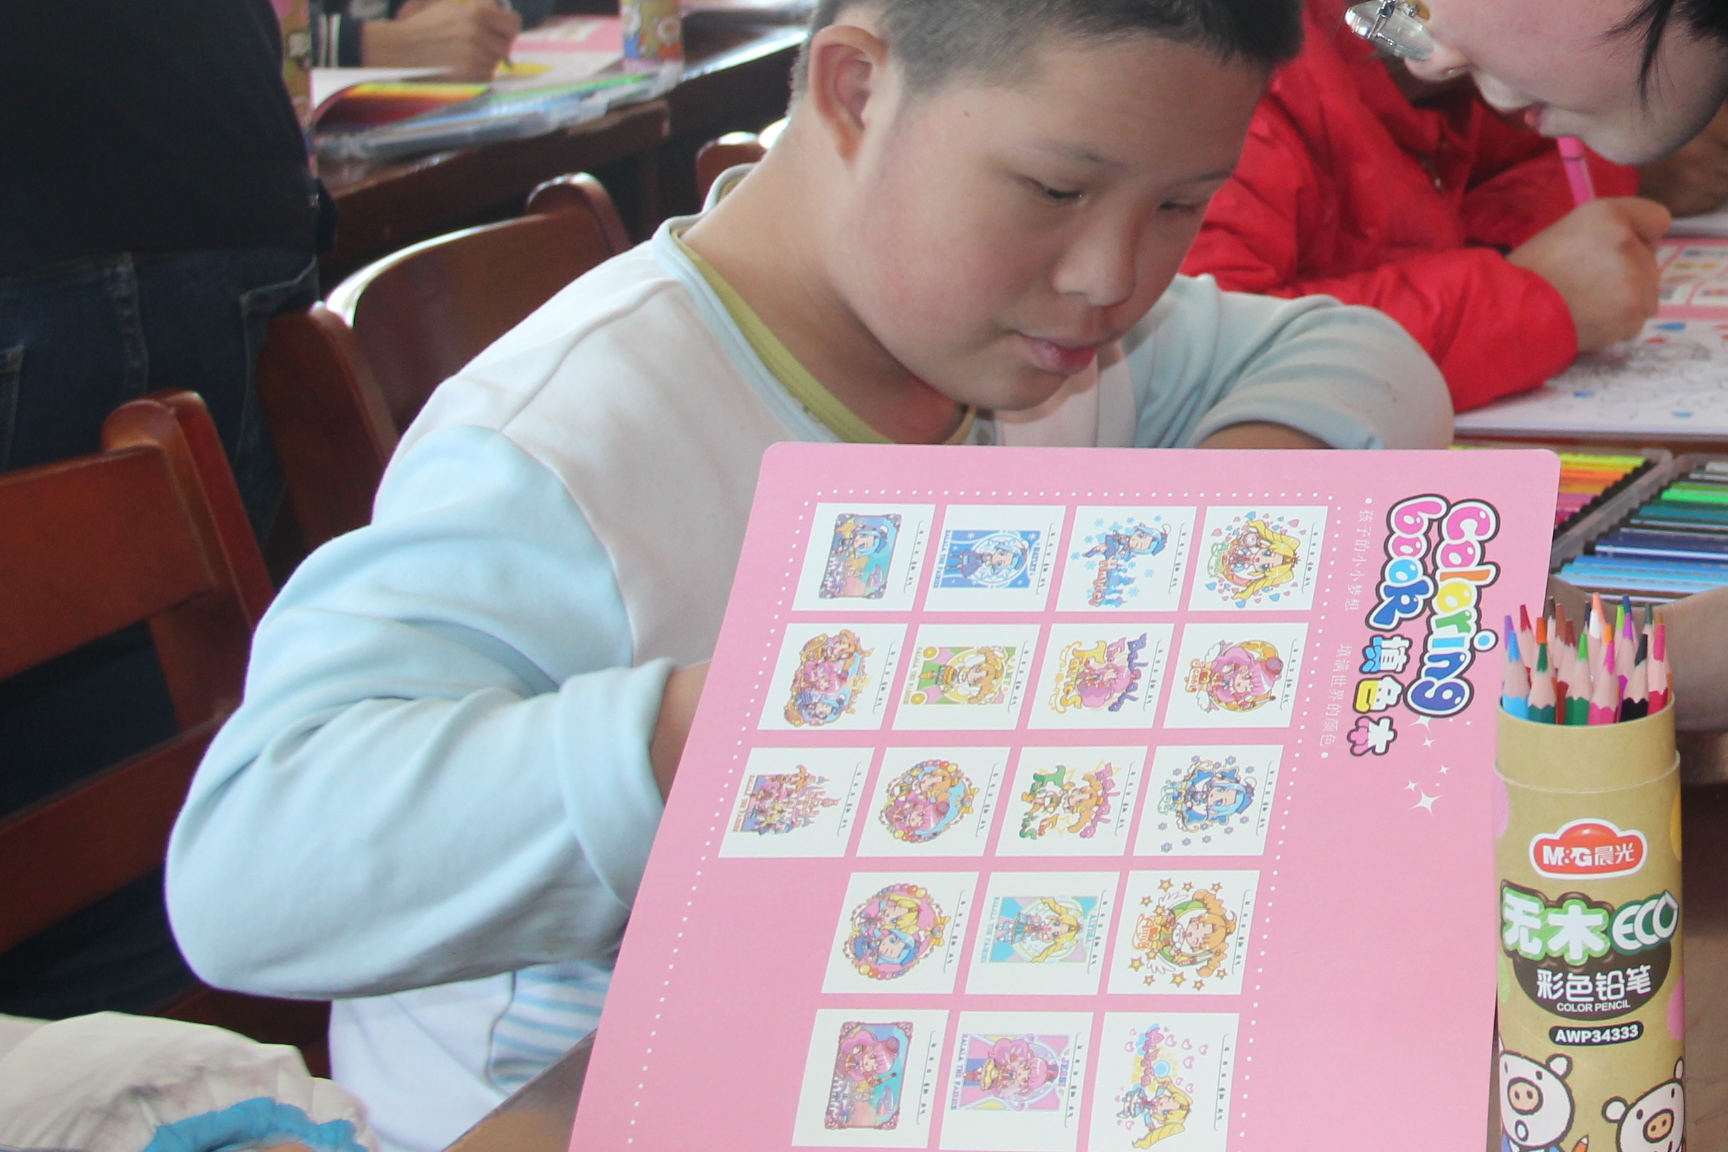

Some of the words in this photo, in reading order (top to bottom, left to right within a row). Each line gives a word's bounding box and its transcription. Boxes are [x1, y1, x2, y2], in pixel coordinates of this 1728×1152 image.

[1344, 509, 1374, 611] 孩子的小小梦想
[1404, 500, 1501, 718] Coloring
[1319, 645, 1352, 747] 填满世界的颜色
[1347, 635, 1412, 756] 填色本
[1537, 964, 1651, 1002] 彩色铅笔
[1556, 1001, 1593, 1013] COLOR
[1595, 999, 1631, 1012] PENCIL
[1555, 1025, 1639, 1044] AWP34333
